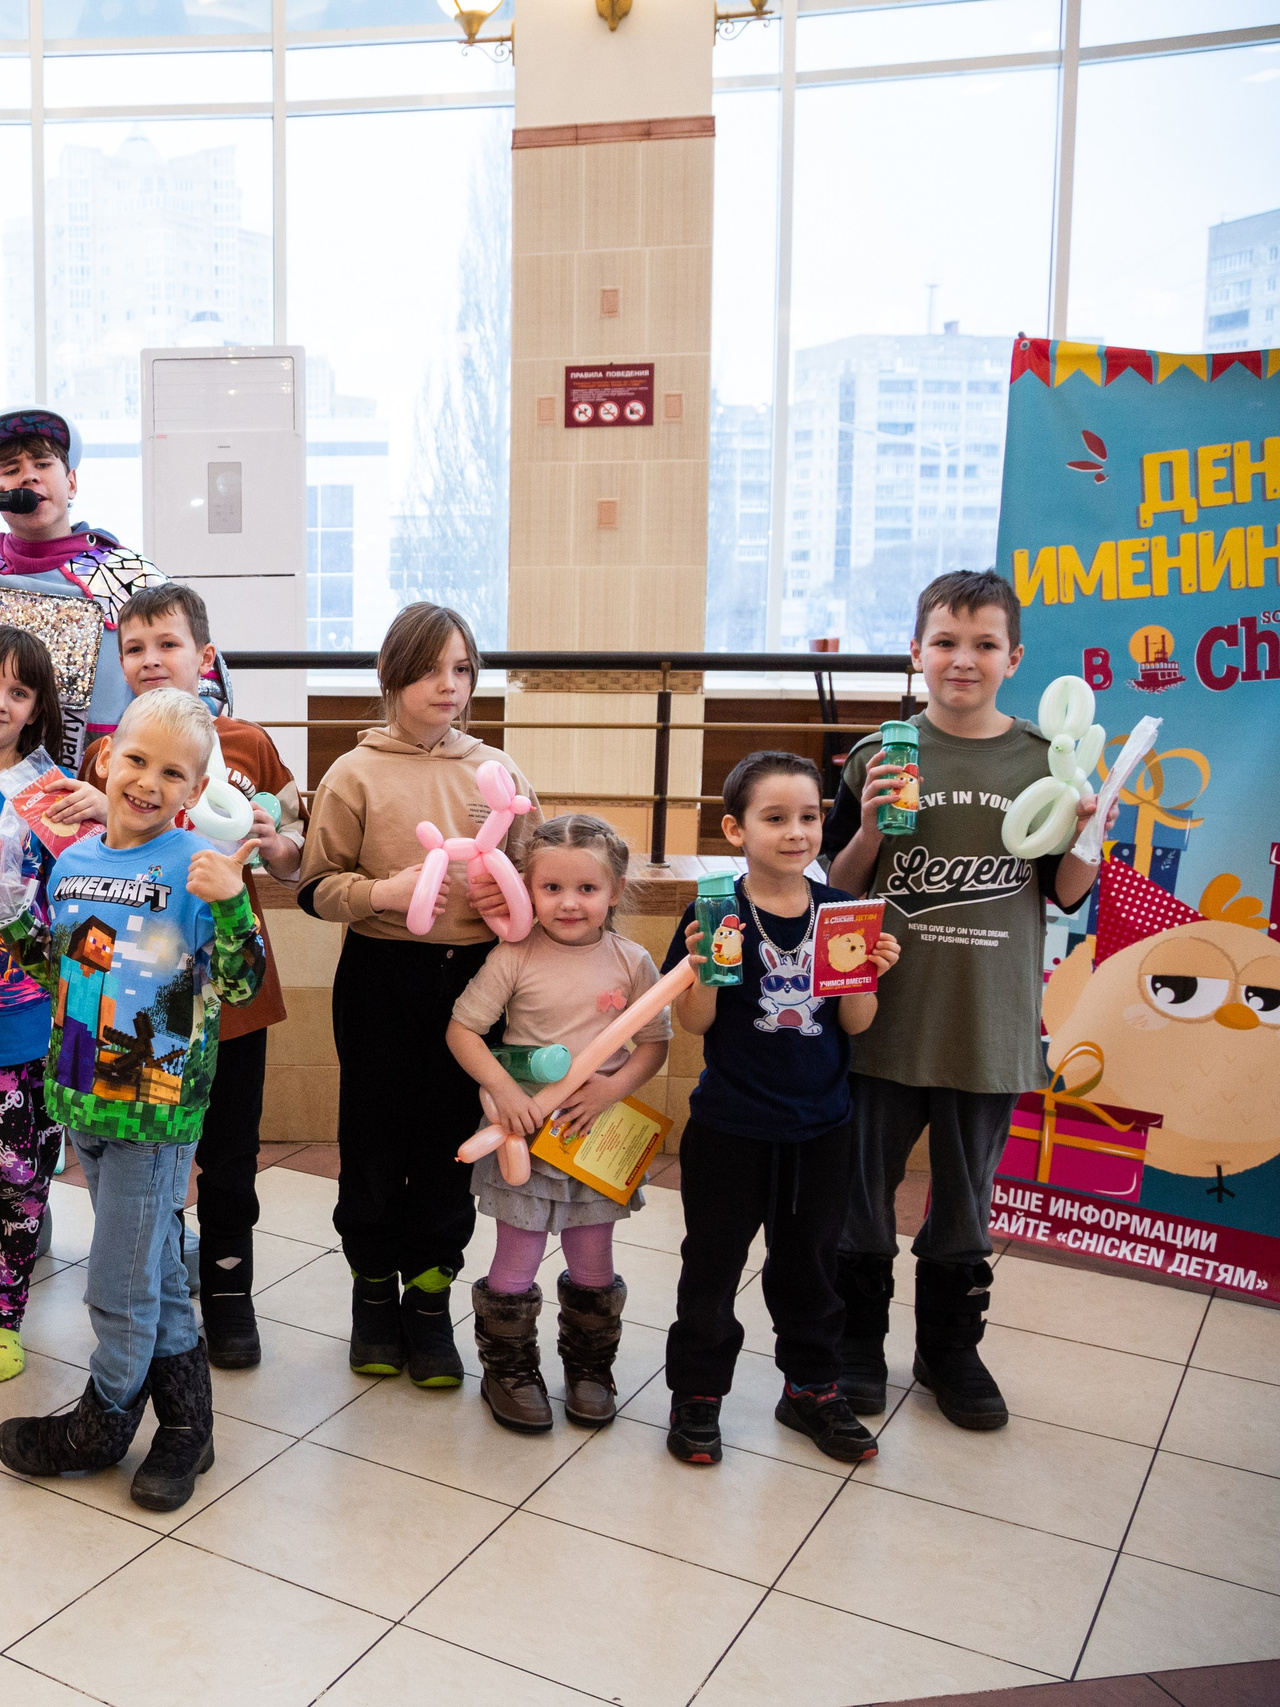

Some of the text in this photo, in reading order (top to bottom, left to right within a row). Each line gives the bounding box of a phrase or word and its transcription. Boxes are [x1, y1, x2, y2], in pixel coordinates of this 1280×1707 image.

[569, 369, 650, 379] ПРАВИЛА ПОВЕДЕНИЯ
[1138, 437, 1280, 528] ДЕН
[1012, 525, 1280, 607] ИМЕНИН
[919, 791, 1013, 812] EVE IN YOU
[53, 876, 172, 912] MINECRAFT
[908, 922, 928, 931] NEVER
[928, 924, 944, 933] GIVE
[945, 926, 956, 934] UP
[957, 927, 968, 935] ON
[969, 928, 987, 936] YOUR
[921, 933, 937, 941] KEEP
[938, 935, 970, 945] PUSHING
[819, 978, 845, 988] УЧИМСЯ
[845, 976, 872, 985] ВМЕСТЕ!
[991, 1183, 1217, 1253] ЬШЕ ИНФОРМАЦИИ
[1057, 1228, 1164, 1268] «CHICKEN
[1167, 1252, 1269, 1291] ДЕТЯМ»
